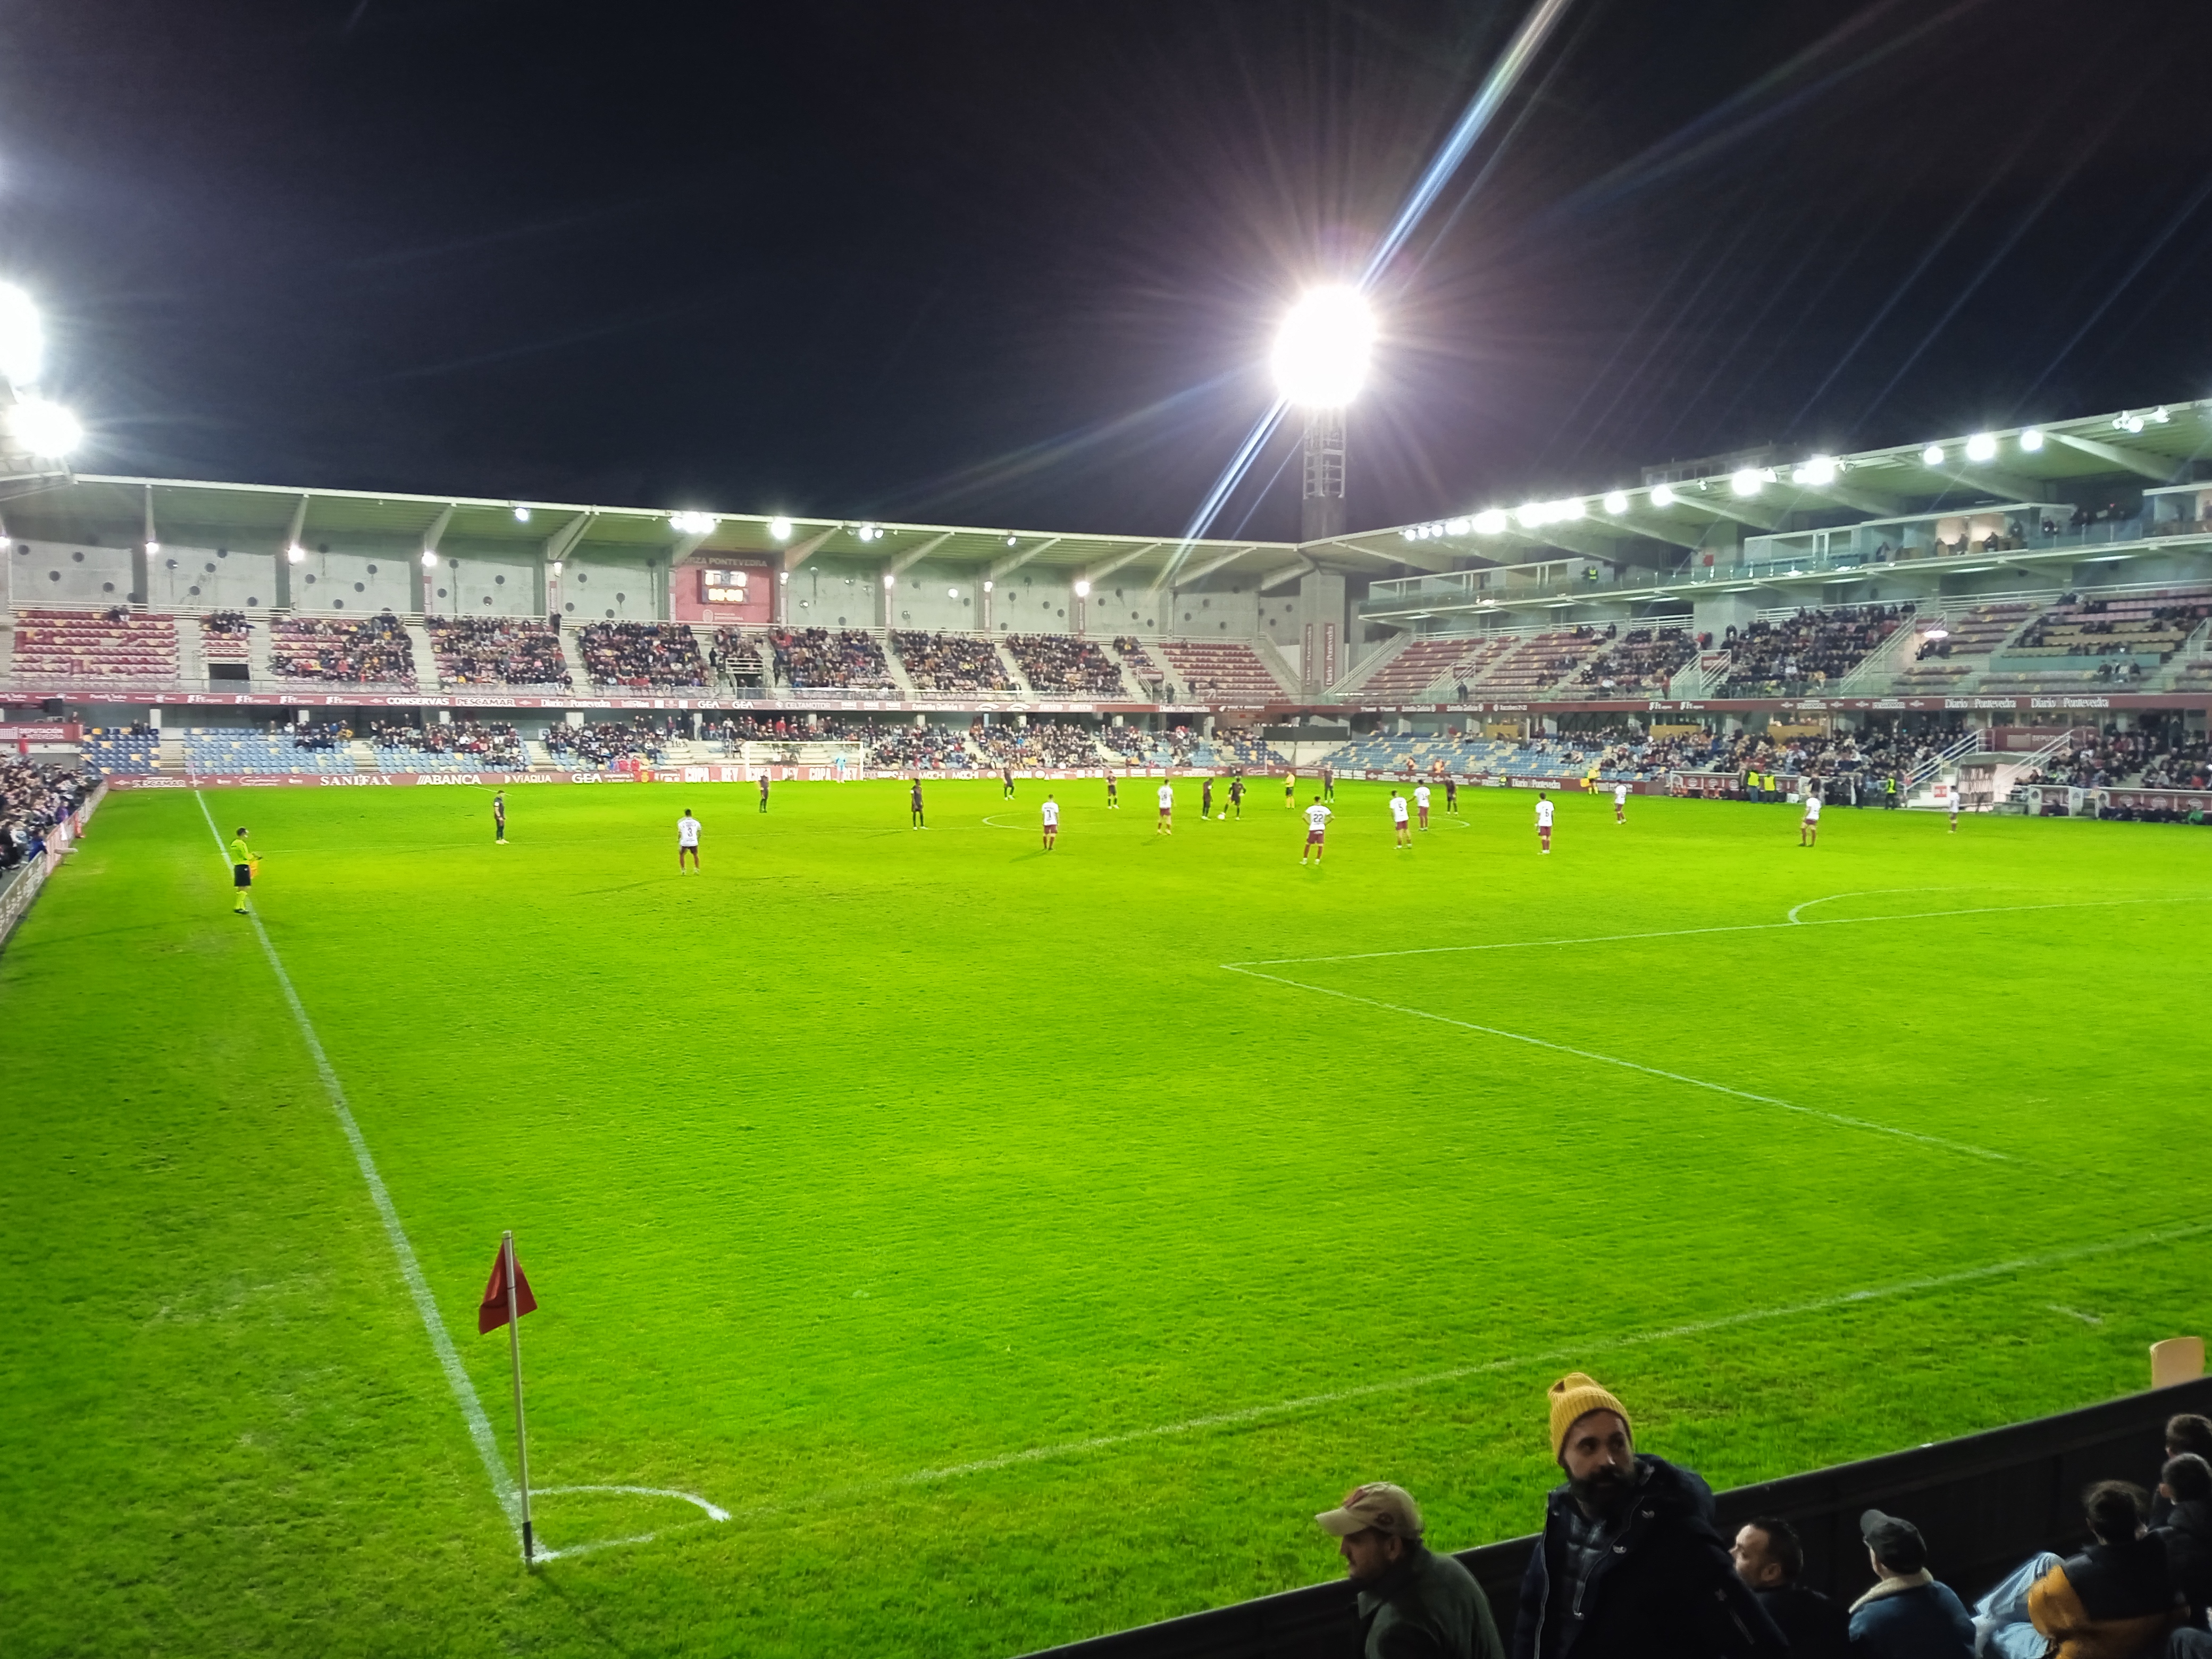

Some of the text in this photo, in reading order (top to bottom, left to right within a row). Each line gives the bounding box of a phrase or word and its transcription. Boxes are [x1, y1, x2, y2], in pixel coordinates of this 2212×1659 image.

[709, 558, 767, 567] PONTEVEDRA
[386, 697, 449, 706] CONSERVAS
[456, 698, 515, 707] PESCAMAR
[541, 699, 564, 707] Diario
[570, 699, 611, 708] Pontevedra
[732, 700, 754, 709] GEA
[785, 701, 831, 710] CELTAMOTOR
[1945, 697, 2016, 708] Diario Pontevedra
[2031, 696, 2109, 708] Diario Pontevedra
[912, 702, 958, 711] Estrella Galicia
[572, 773, 602, 784] GEA
[685, 767, 710, 783] COPA
[722, 767, 739, 782] REY
[809, 767, 832, 781] COPA
[423, 775, 482, 785] ABANCA
[1511, 778, 1528, 787] Diario
[1532, 780, 1561, 790] Pontevedra
[1313, 814, 1323, 823] 22
